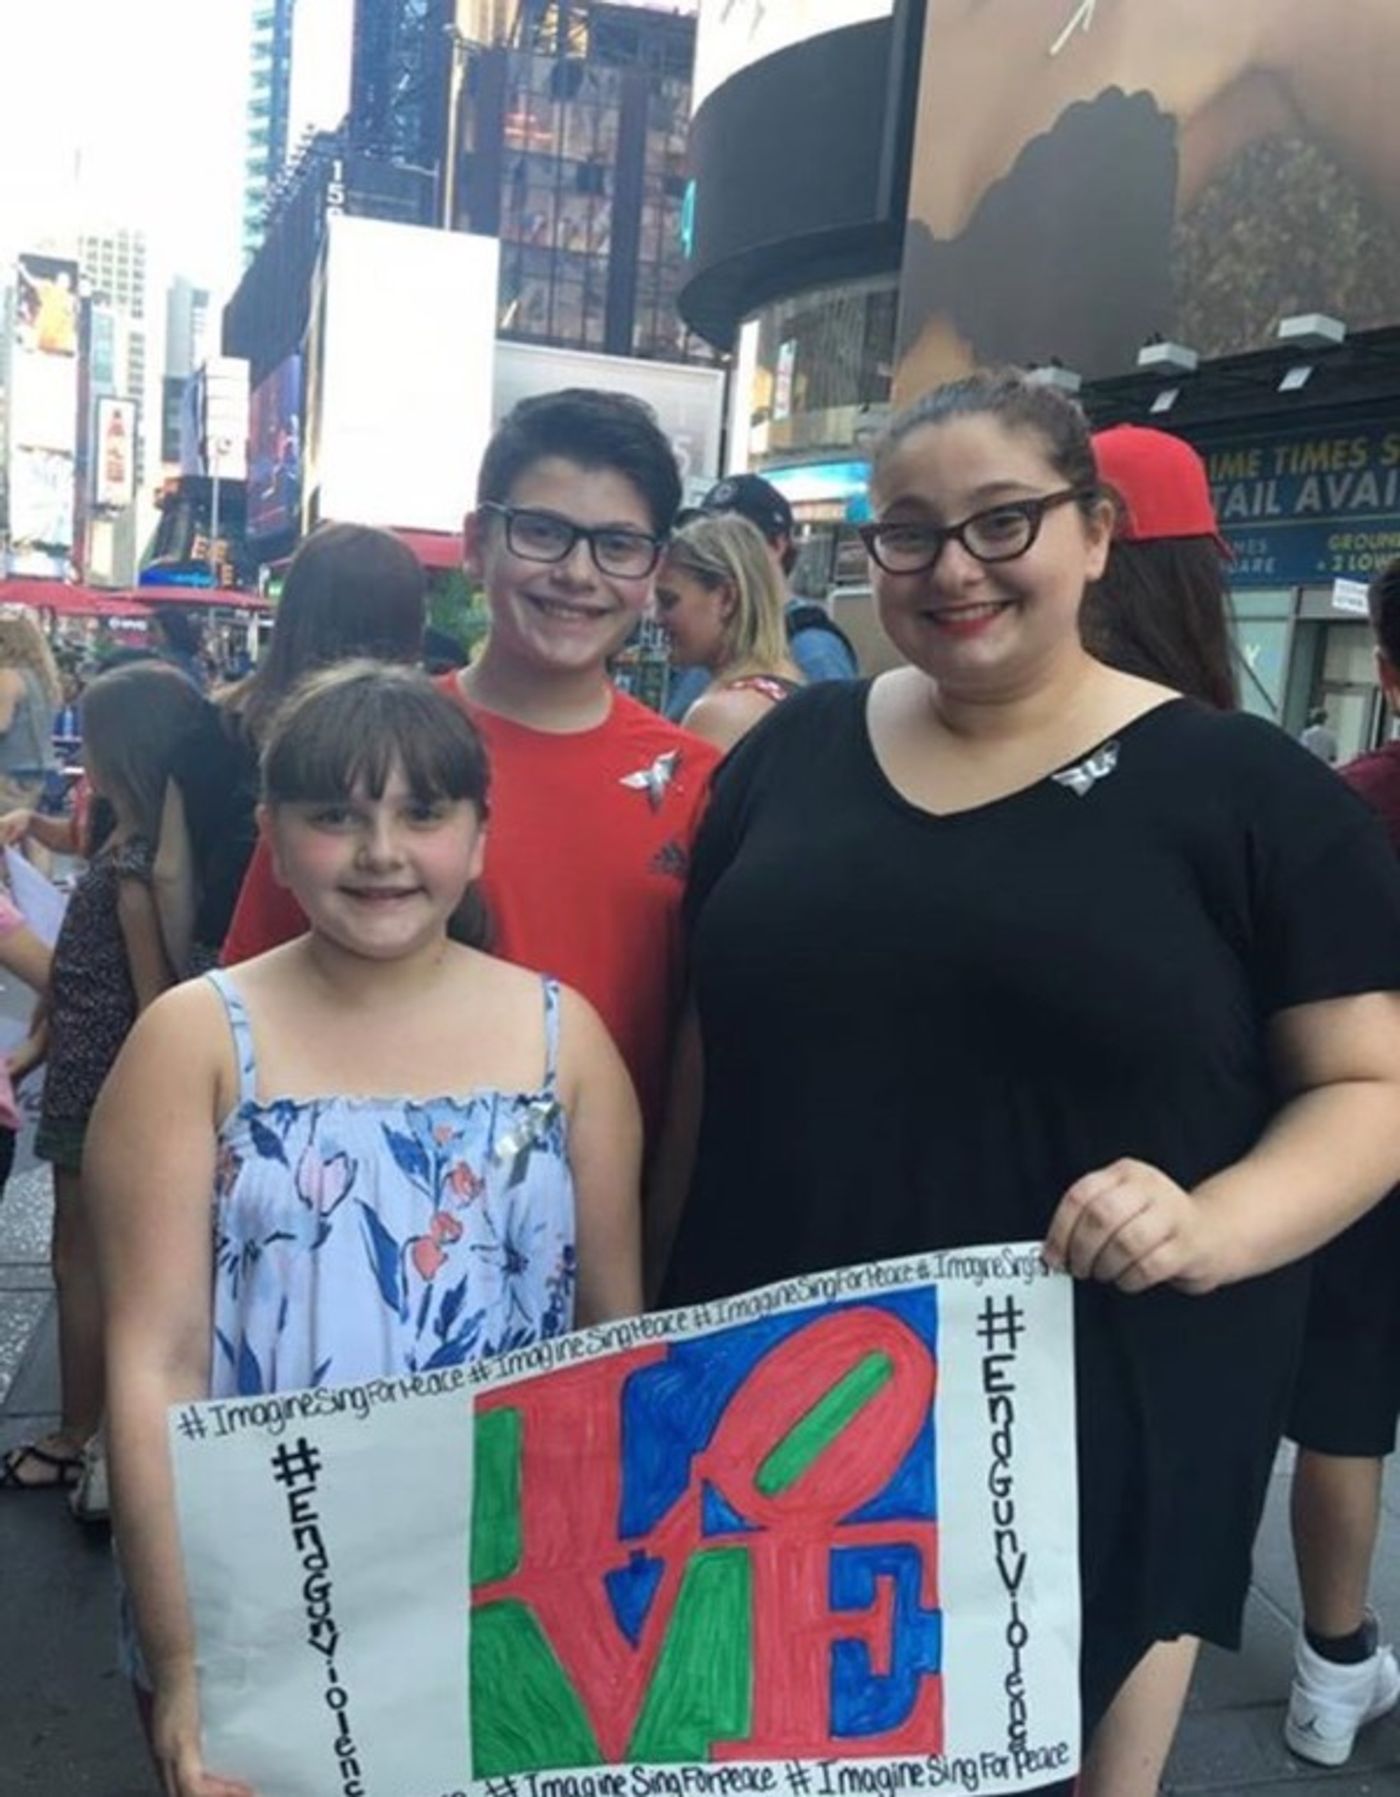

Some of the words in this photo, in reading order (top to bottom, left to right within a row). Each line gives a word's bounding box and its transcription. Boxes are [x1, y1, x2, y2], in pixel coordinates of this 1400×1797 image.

[1274, 438, 1369, 475] TIMES
[1213, 480, 1281, 517] TAIL
[1295, 469, 1399, 513] AVAI
